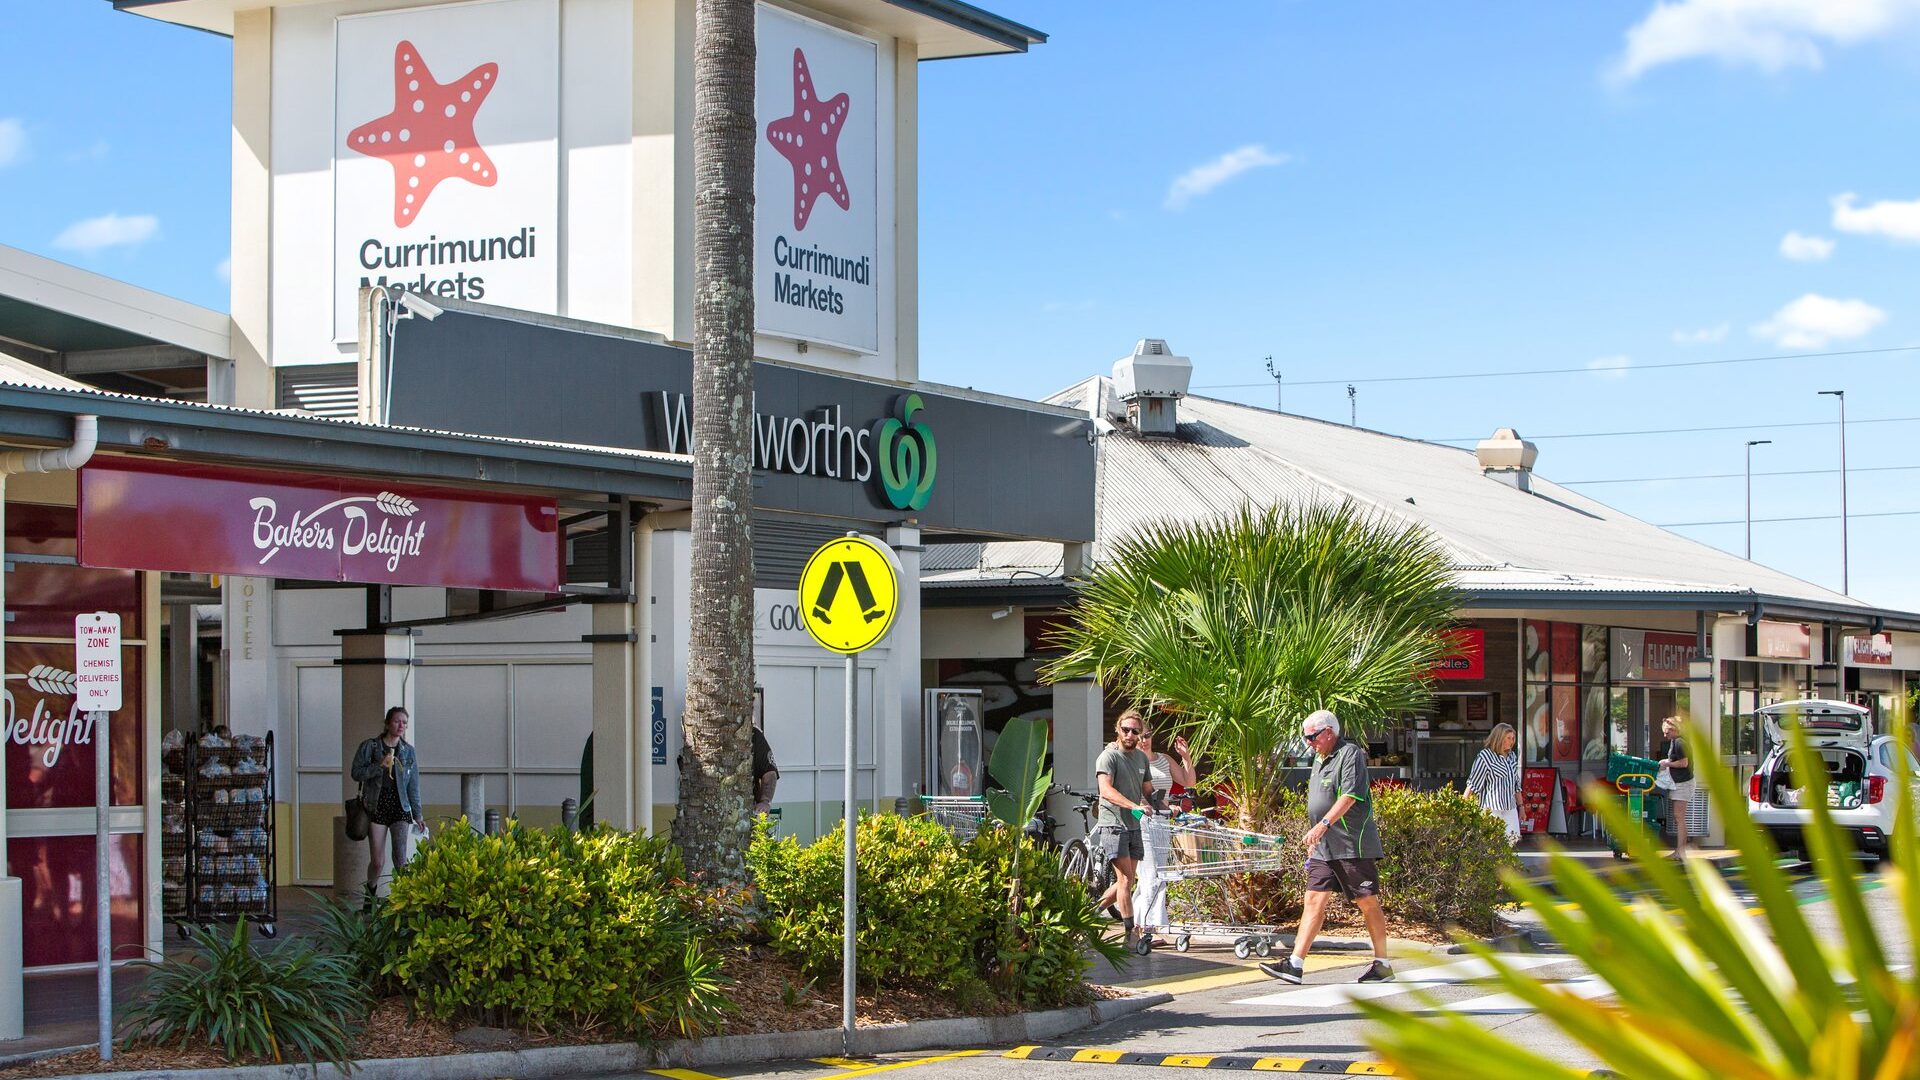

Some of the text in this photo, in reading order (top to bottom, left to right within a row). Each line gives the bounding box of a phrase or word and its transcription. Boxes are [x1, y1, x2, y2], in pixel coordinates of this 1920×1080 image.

[358, 226, 536, 270] Currimundi
[773, 235, 870, 286] Currimundi
[774, 271, 844, 315] Markets
[662, 390, 872, 482] Wlworths
[250, 496, 427, 572] Bakers Delight
[79, 626, 117, 635] TOW-AWAY
[87, 638, 110, 648] ZONE
[83, 659, 115, 668] CHEMIST
[1647, 643, 1685, 671] FLIGHT
[79, 674, 119, 682] DELIVERIES
[89, 689, 110, 697] ONLY
